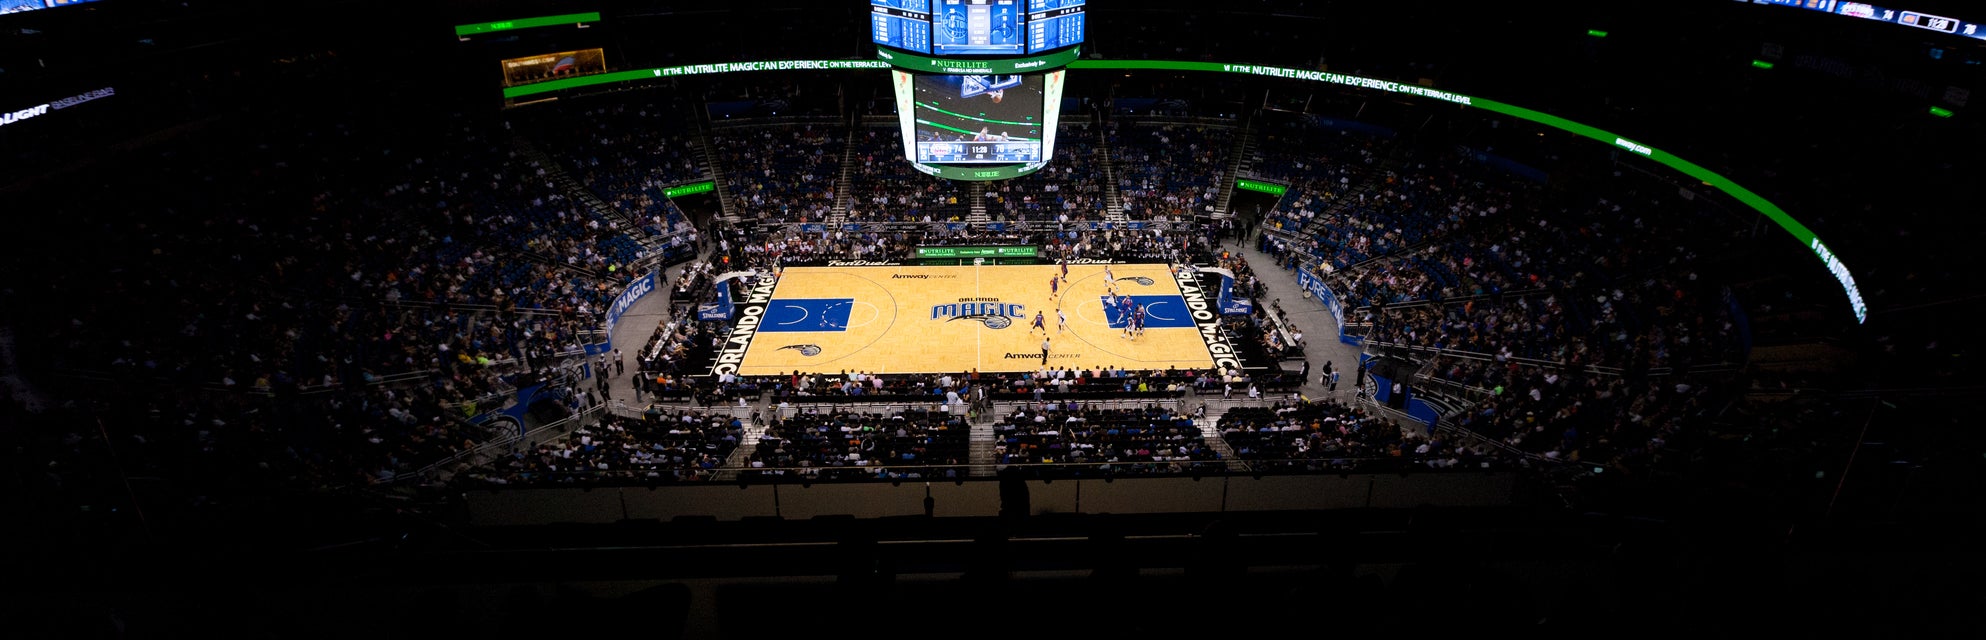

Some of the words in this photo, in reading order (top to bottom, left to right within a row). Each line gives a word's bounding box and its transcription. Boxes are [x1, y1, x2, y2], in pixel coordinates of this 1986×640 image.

[684, 63, 728, 75] NUTRILITE
[729, 61, 759, 72] MAGIC
[759, 61, 777, 70] FAN
[778, 60, 828, 69] EXPERIENCE
[937, 60, 988, 69] NUTRILITE
[1252, 65, 1295, 78] NUTRILITE
[1296, 70, 1326, 81] MAGIC
[1325, 73, 1344, 84] FAN
[1345, 75, 1398, 92] EXPERIENCE
[1398, 84, 1410, 93] ON
[1410, 86, 1424, 95] THE
[1423, 88, 1452, 101] TERRACE
[1452, 94, 1471, 105] LEVEL
[3, 104, 50, 124] LIGHT
[671, 184, 710, 195] NUTRILITE
[1244, 182, 1282, 194] NUTRILITE
[618, 278, 651, 313] MAGIC
[1177, 271, 1213, 321] RLANDO
[930, 302, 1026, 320] MAGIC
[714, 305, 764, 376] ORLANDO
